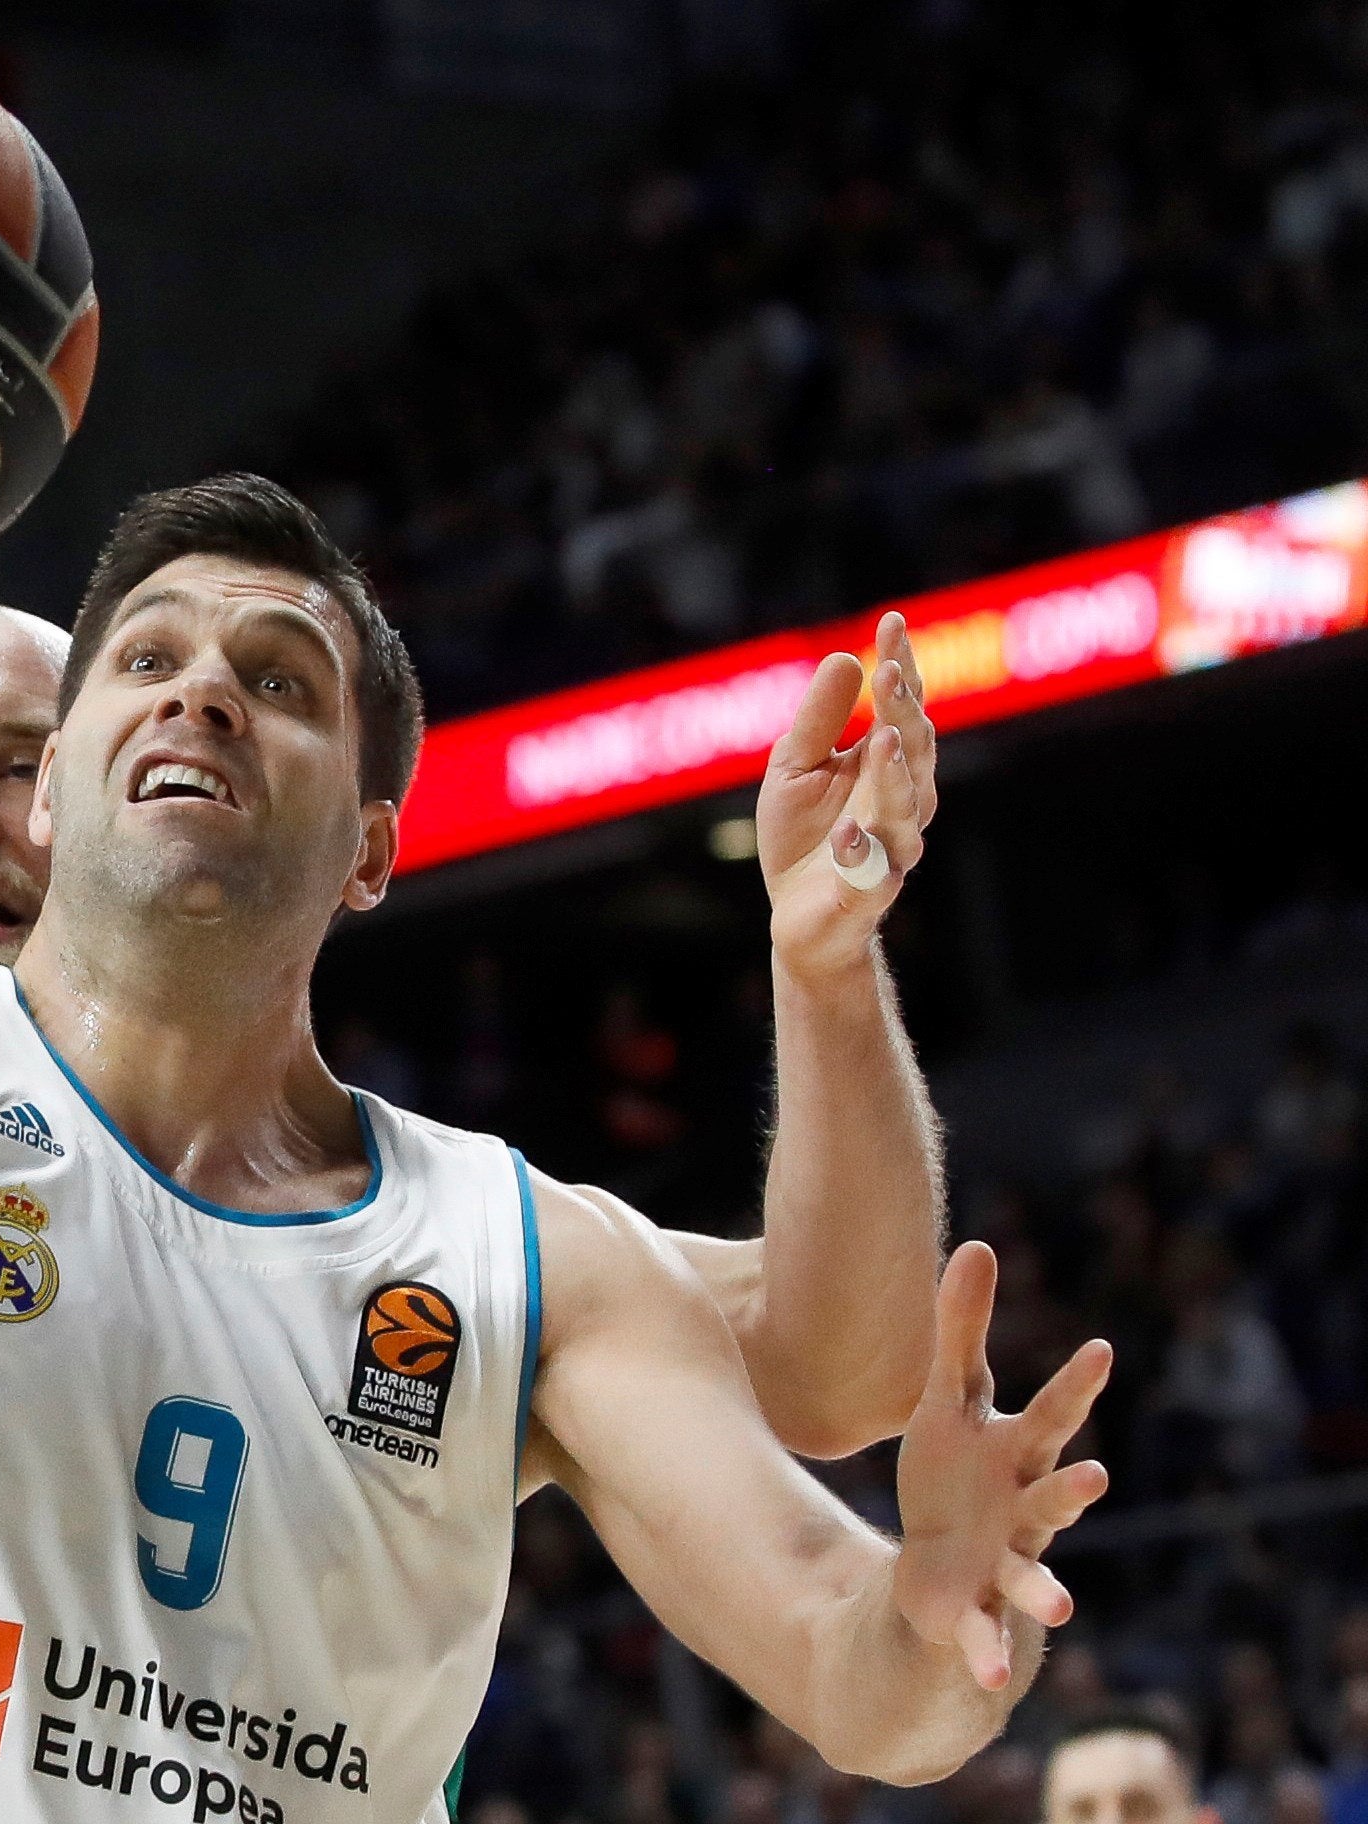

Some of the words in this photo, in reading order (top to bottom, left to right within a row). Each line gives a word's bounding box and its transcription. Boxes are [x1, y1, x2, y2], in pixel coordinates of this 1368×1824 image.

[360, 1382, 436, 1414] AIRLINES
[364, 1366, 439, 1400] TURKISH
[324, 1414, 440, 1469] oneteam
[135, 1394, 251, 1612] 9
[43, 1636, 370, 1793] Universida
[33, 1713, 284, 1824] Europea
